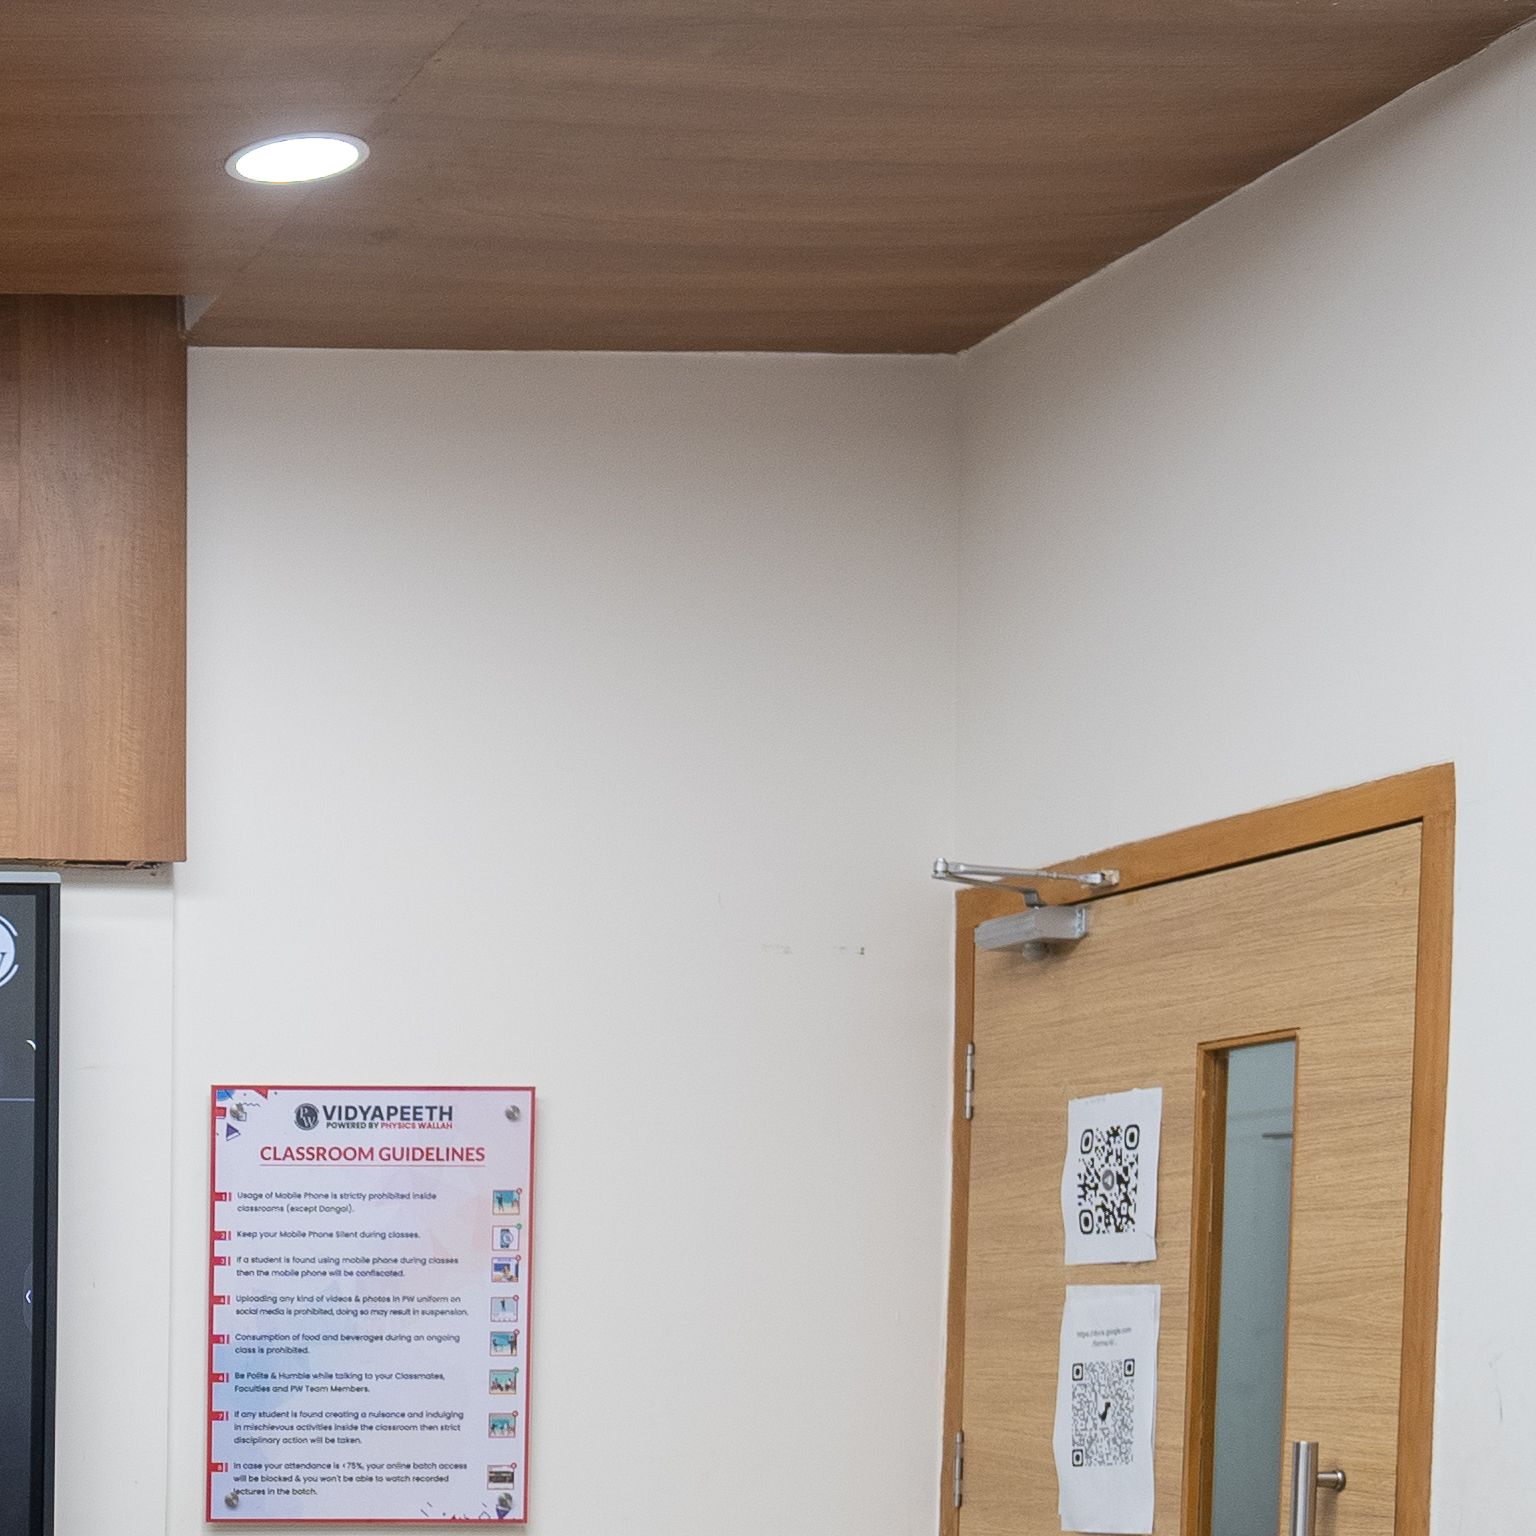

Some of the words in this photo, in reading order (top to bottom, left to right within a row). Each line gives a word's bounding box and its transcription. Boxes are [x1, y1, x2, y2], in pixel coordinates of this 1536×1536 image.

[322, 1105, 453, 1122] VIDYAPEETH
[260, 1147, 374, 1162] CLASSROOM
[378, 1147, 486, 1162] GUIDELINES
[237, 1192, 263, 1201] Usage
[340, 1192, 366, 1201] strictly
[368, 1192, 410, 1201] prohibited
[237, 1231, 257, 1239] Keep
[360, 1231, 386, 1240] during
[251, 1256, 281, 1264] student
[284, 1256, 290, 1264] is
[292, 1256, 315, 1264] found
[318, 1257, 340, 1266] using
[342, 1256, 370, 1264] mobile
[372, 1256, 397, 1266] phone
[400, 1256, 426, 1266] during
[428, 1256, 458, 1264] classes
[272, 1269, 299, 1277] mobile
[301, 1269, 327, 1278] phone
[329, 1269, 341, 1277] will
[344, 1269, 354, 1277] be
[356, 1269, 405, 1277] confiscated.
[235, 1334, 289, 1343] Consumption
[340, 1334, 383, 1343] beverages
[385, 1334, 412, 1343] during
[427, 1334, 460, 1343] ongoing
[235, 1346, 255, 1354] class
[258, 1346, 264, 1354] is
[266, 1346, 309, 1356] prohibited.
[235, 1372, 245, 1380] Be
[247, 1372, 268, 1380] Polite
[279, 1372, 311, 1380] Humble
[312, 1372, 333, 1380] while
[335, 1372, 363, 1382] talking
[365, 1372, 373, 1380] to
[375, 1374, 393, 1382] your
[395, 1372, 445, 1381] Classmates,
[330, 1385, 370, 1393] Members.
